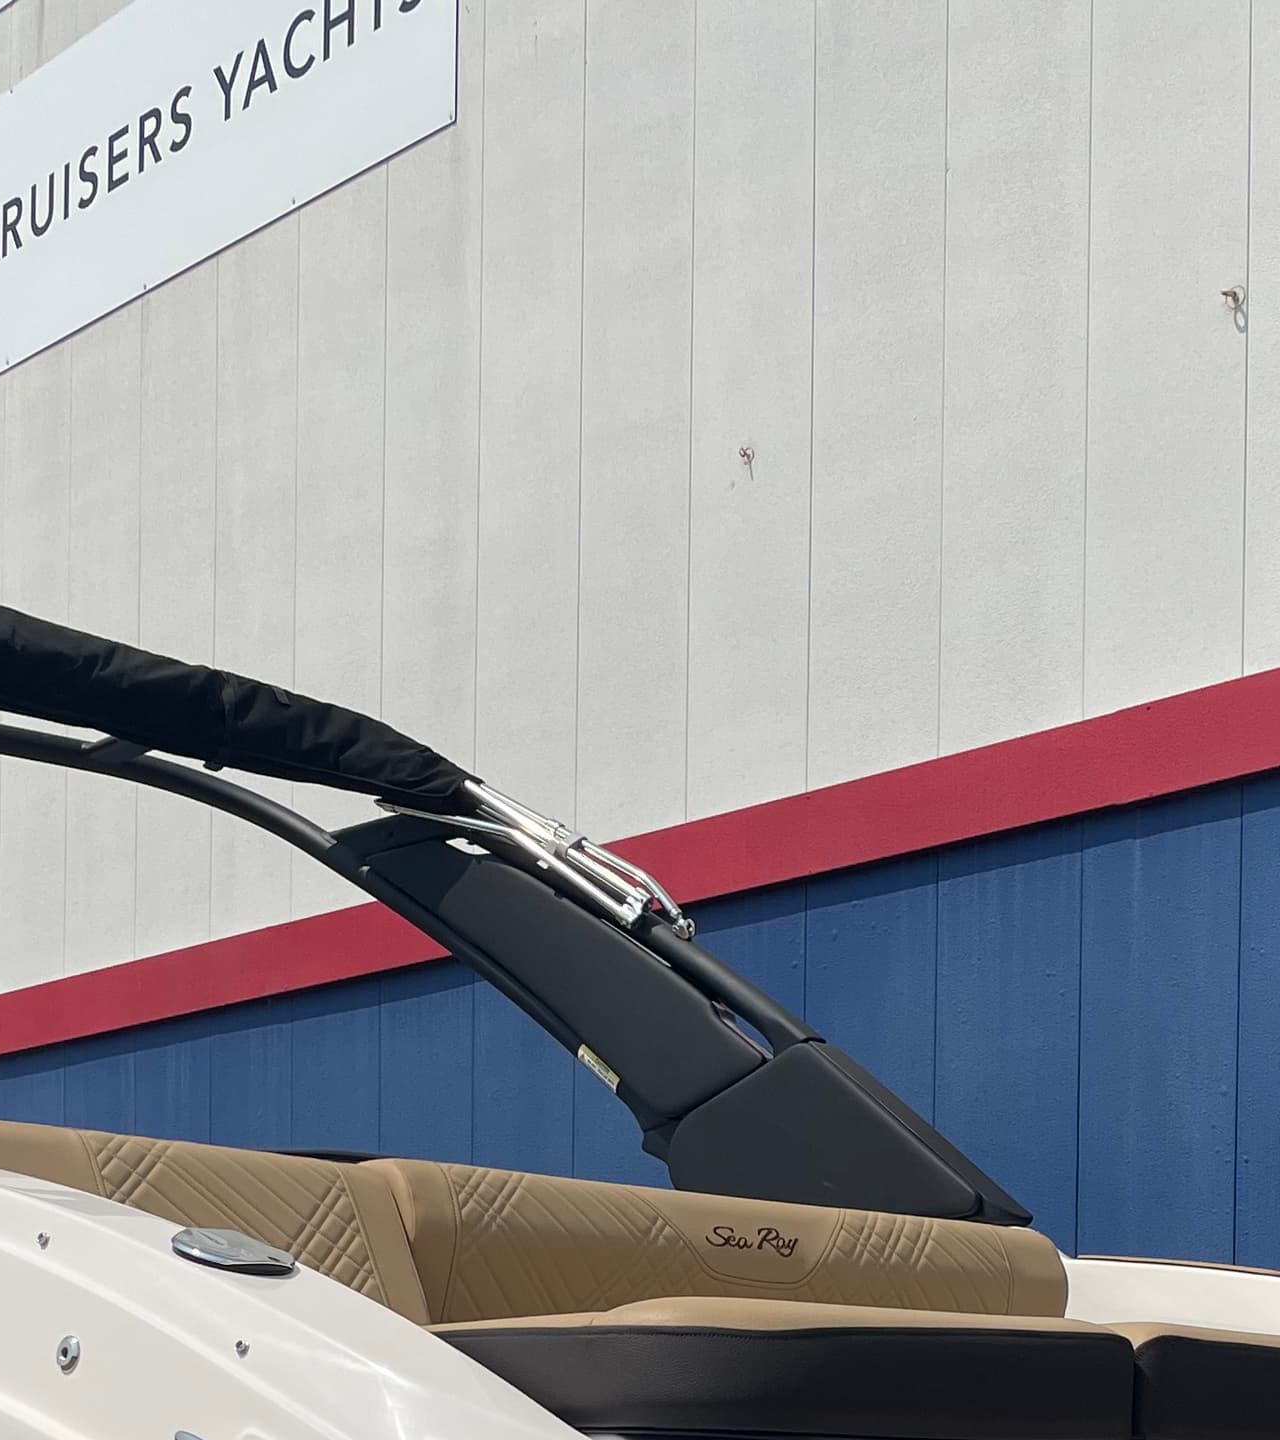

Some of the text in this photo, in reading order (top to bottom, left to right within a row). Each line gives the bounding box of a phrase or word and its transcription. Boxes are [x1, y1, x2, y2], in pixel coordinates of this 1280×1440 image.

[212, 0, 422, 121] YACH
[705, 1226, 799, 1258] Sea Ray
